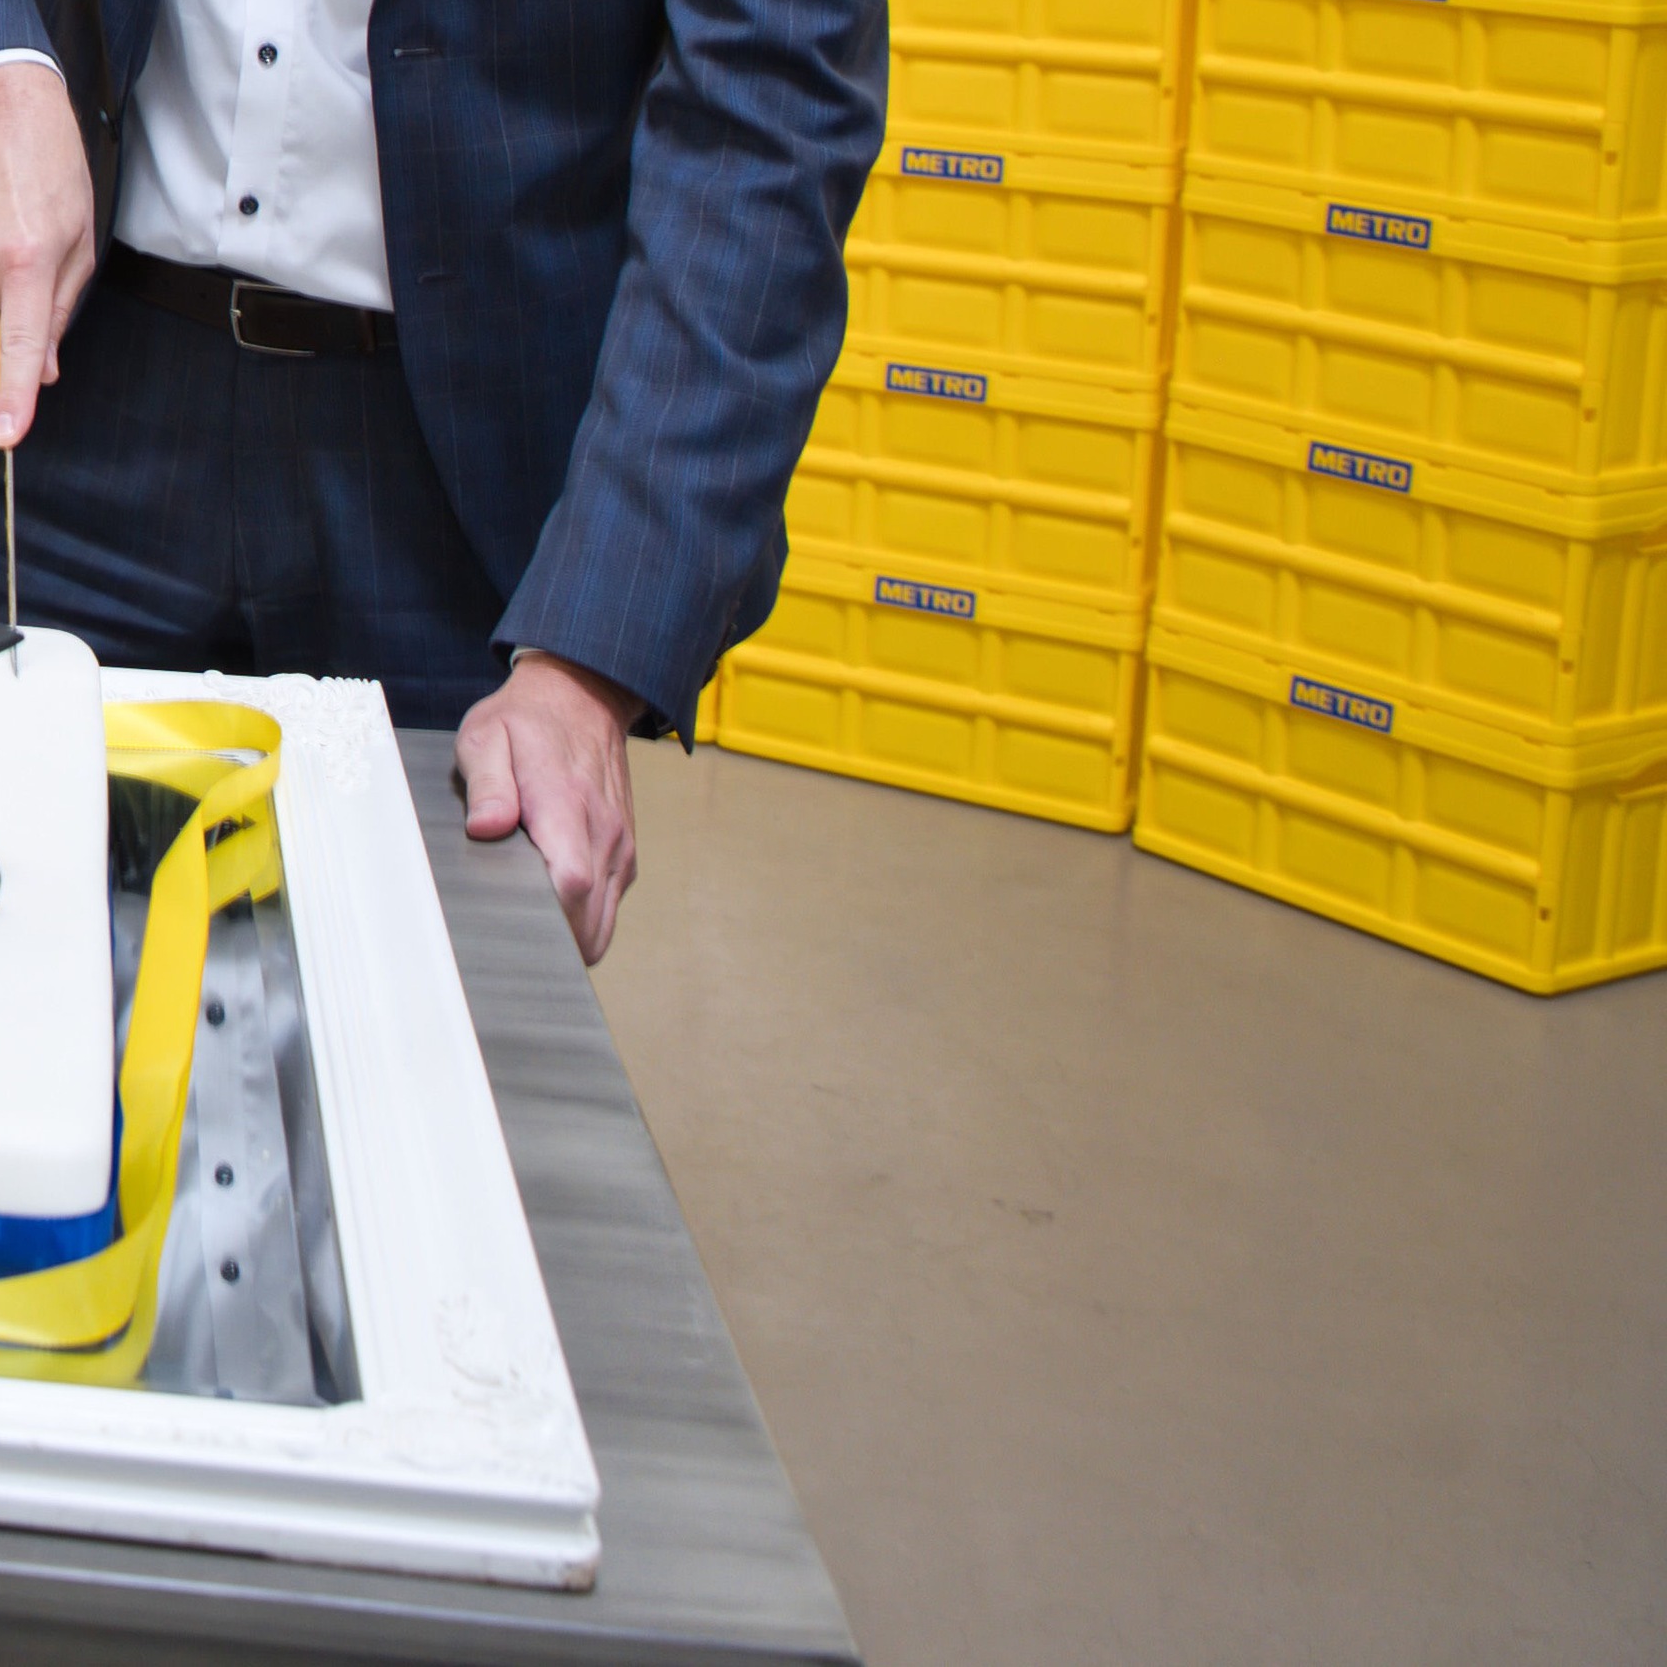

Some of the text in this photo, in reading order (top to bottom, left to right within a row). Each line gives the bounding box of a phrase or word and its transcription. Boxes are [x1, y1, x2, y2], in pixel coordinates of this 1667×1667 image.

[906, 150, 1000, 179] METRO
[1331, 208, 1427, 245] METRO
[890, 367, 983, 399] METRO
[1313, 446, 1408, 488] METRO
[880, 579, 971, 614] METRO
[1295, 681, 1389, 728] METRO
